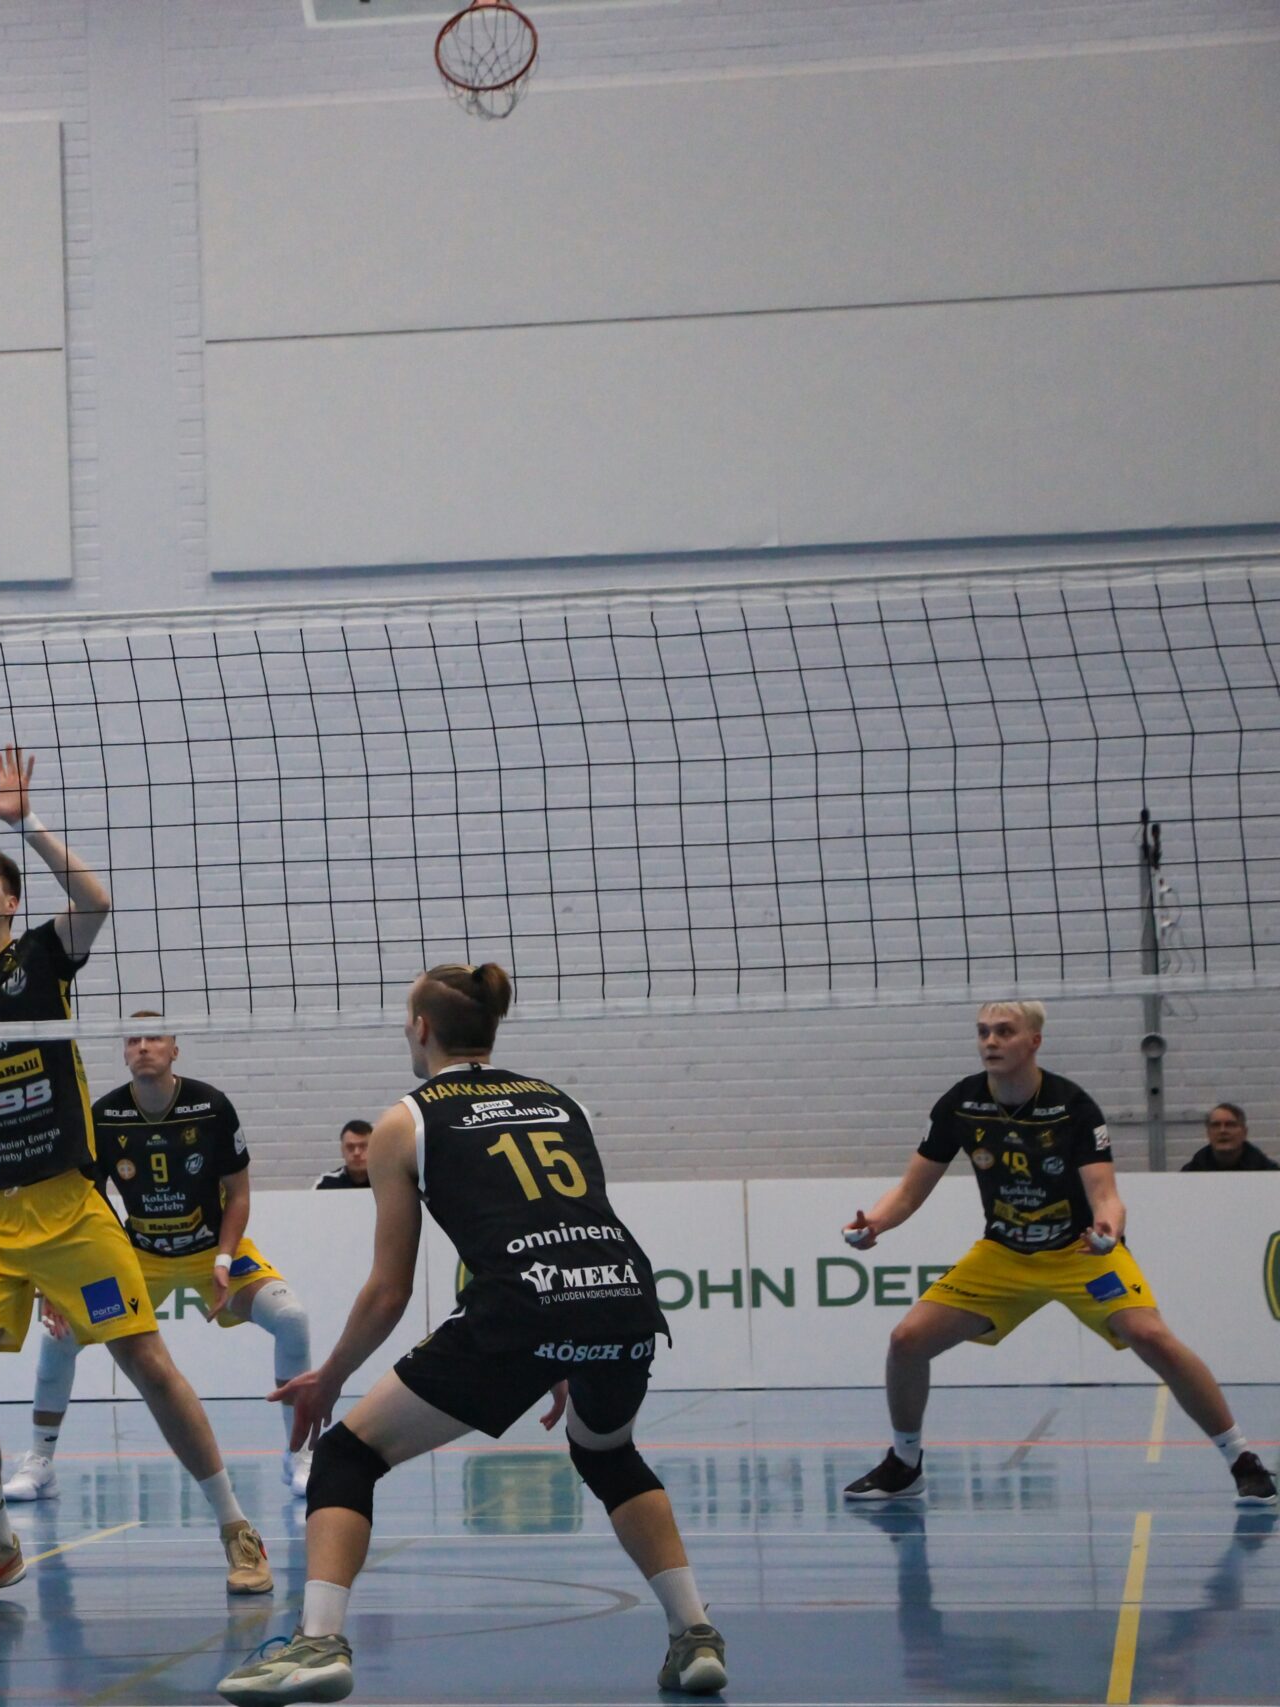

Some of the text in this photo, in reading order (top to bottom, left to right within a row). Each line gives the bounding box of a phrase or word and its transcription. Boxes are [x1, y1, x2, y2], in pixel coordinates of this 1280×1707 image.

[420, 1080, 559, 1103] HAKKARAINEN
[462, 1107, 555, 1126] SAARELAINEN
[28, 1127, 61, 1143] Energia
[150, 1153, 169, 1183] 9
[486, 1131, 588, 1201] 15
[561, 1261, 639, 1288] MEKA
[539, 1287, 643, 1305] 70 VUODEN KOKEMUKSELLA
[652, 1267, 795, 1311] OHN
[534, 1337, 654, 1362] RÖSCH OY
